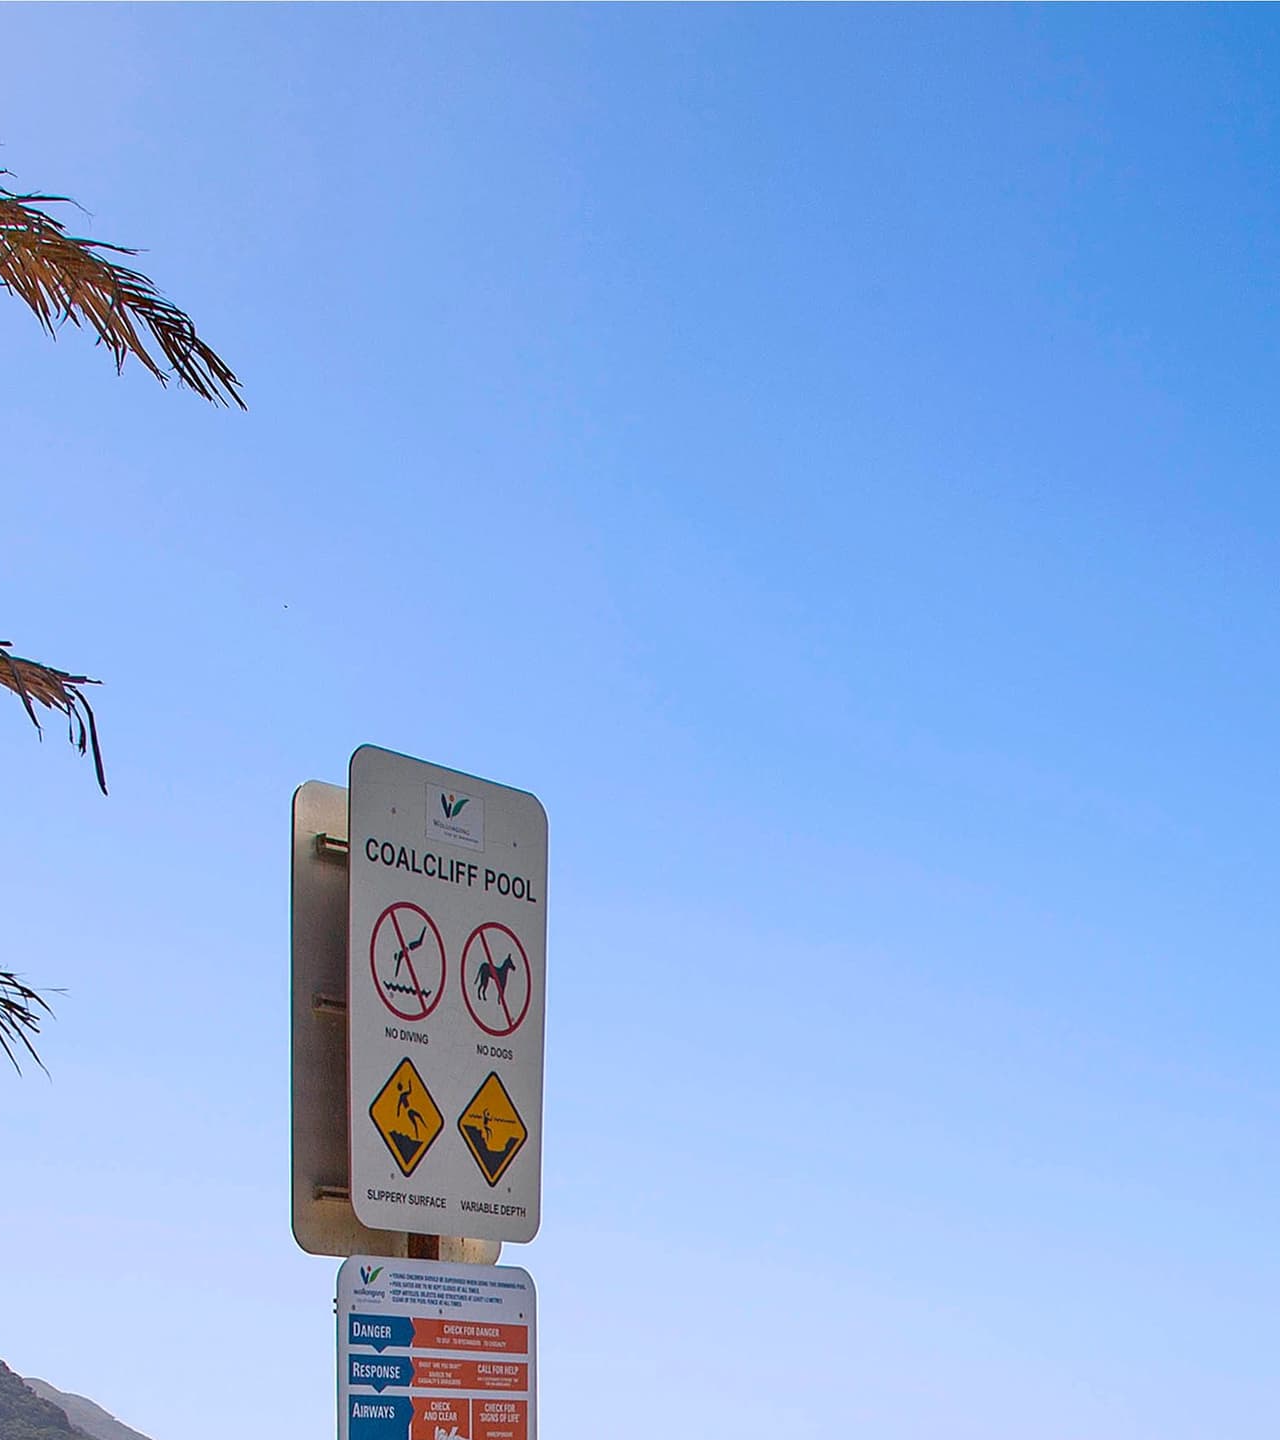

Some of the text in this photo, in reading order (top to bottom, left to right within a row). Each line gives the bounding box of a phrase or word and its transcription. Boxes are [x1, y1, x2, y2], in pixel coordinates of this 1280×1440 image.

[366, 838, 536, 903] COALCLIFF POOL
[385, 1027, 429, 1045] NO DIVING
[477, 1044, 513, 1060] NO DOGS
[367, 1189, 447, 1209] SLIPPERY SURFACE
[460, 1200, 526, 1217] VARIABLE DEPTH
[353, 1322, 391, 1338] DANGER
[443, 1325, 499, 1337] CHECK FOR DANGER
[353, 1362, 400, 1379] RESPONSE
[477, 1364, 519, 1375] CALL FOR HELP
[352, 1403, 395, 1419] AIRWAYS
[431, 1401, 450, 1411] CHECK
[484, 1403, 515, 1413] CHECK FOR
[424, 1411, 457, 1421] AND CLEAR
[500, 1413, 506, 1422] OF
